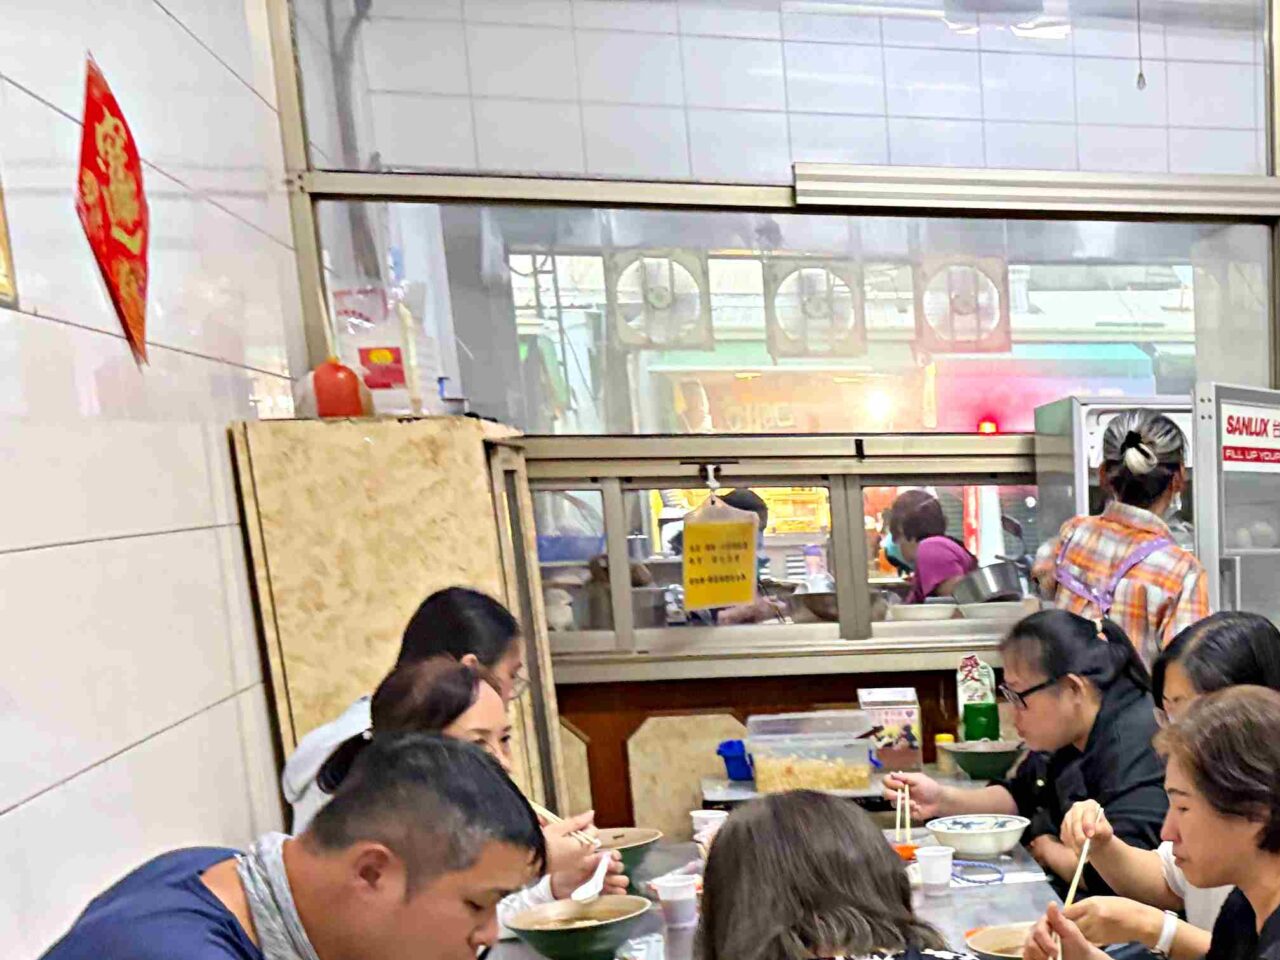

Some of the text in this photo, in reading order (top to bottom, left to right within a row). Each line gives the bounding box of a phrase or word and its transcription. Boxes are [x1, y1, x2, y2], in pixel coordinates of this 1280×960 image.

[1226, 415, 1270, 438] SANLUX
[1225, 449, 1243, 459] FILL
[1245, 450, 1258, 460] UP
[1260, 451, 1280, 461] YOUR
